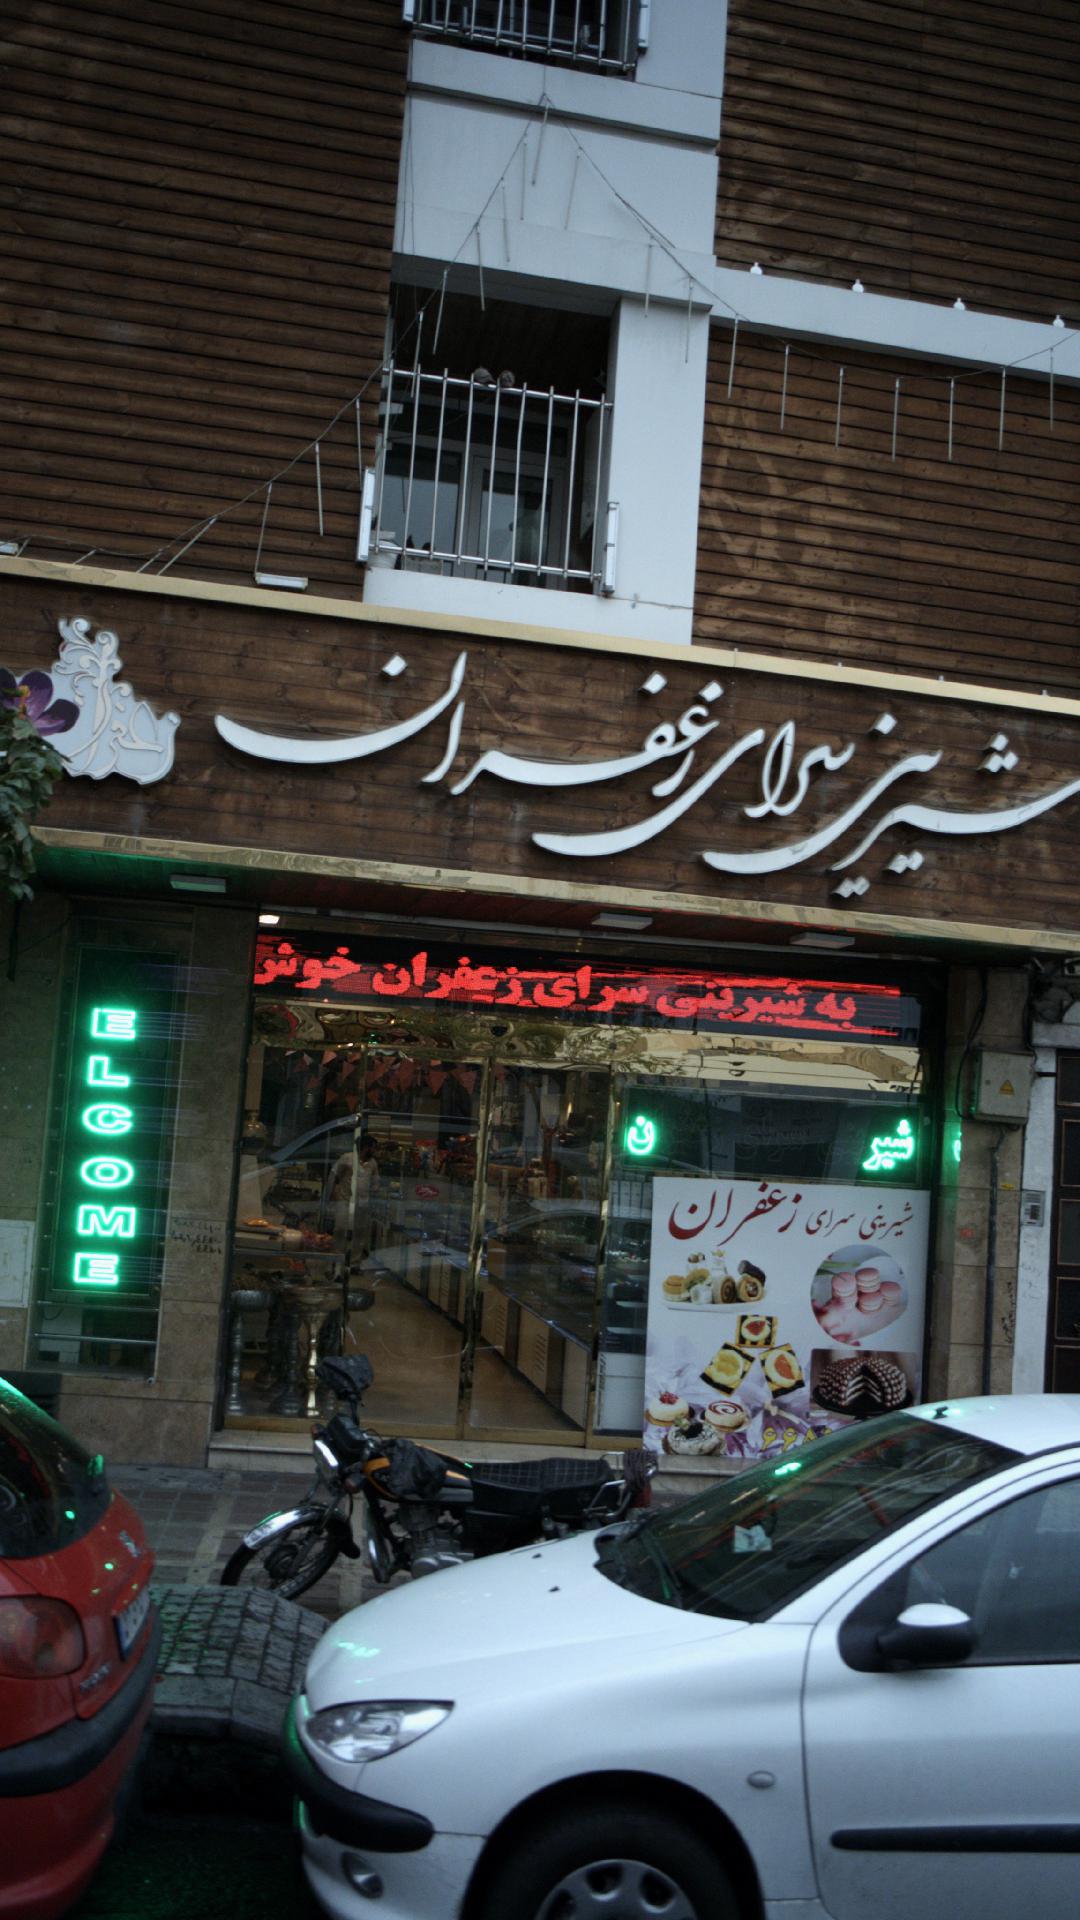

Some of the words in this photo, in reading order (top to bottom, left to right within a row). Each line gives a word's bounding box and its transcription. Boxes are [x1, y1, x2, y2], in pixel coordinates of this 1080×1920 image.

[214, 650, 724, 797] زعفران
[531, 719, 856, 857] سرای
[372, 951, 541, 1008] زعفران
[532, 964, 648, 1013] سرای
[656, 980, 806, 1024] شیرینی
[815, 991, 857, 1030] به
[668, 1182, 802, 1247] زعفران
[805, 1209, 856, 1238] سرای
[858, 1201, 914, 1241] شیرینی
